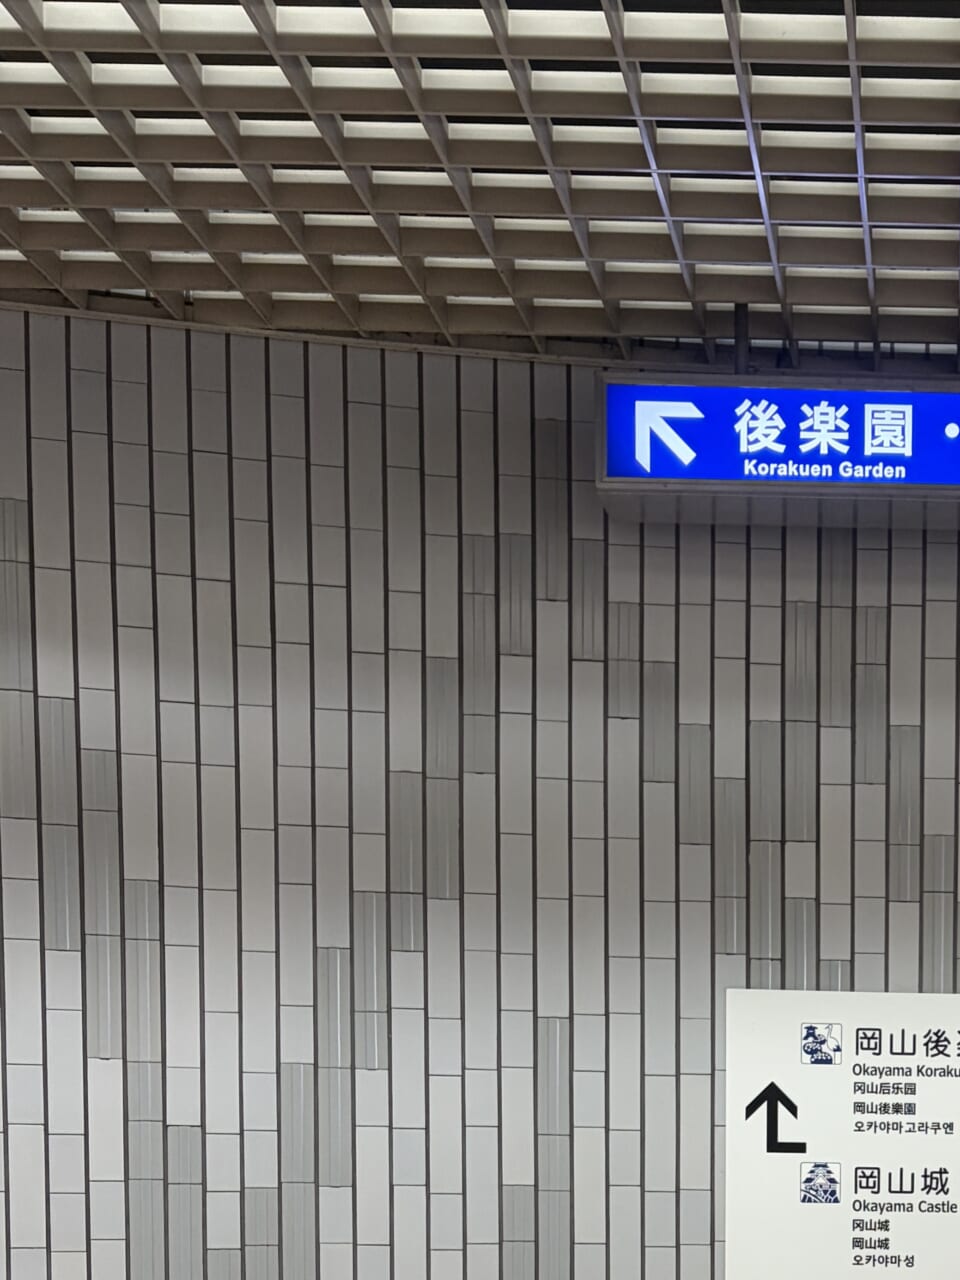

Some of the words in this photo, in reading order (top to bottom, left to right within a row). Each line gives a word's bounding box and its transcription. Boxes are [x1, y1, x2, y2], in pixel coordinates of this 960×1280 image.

[743, 459, 833, 478] Korakuen
[838, 460, 907, 480] Garden
[852, 1063, 912, 1079] Okayama
[853, 1081, 917, 1095] 冈山后乐园
[853, 1101, 916, 1115] 岡山後樂園
[854, 1166, 950, 1195] 岡山城
[852, 1199, 914, 1215] Okayama
[918, 1200, 958, 1213] Castle
[852, 1218, 890, 1232] 冈山城
[852, 1237, 890, 1250] 岡山城
